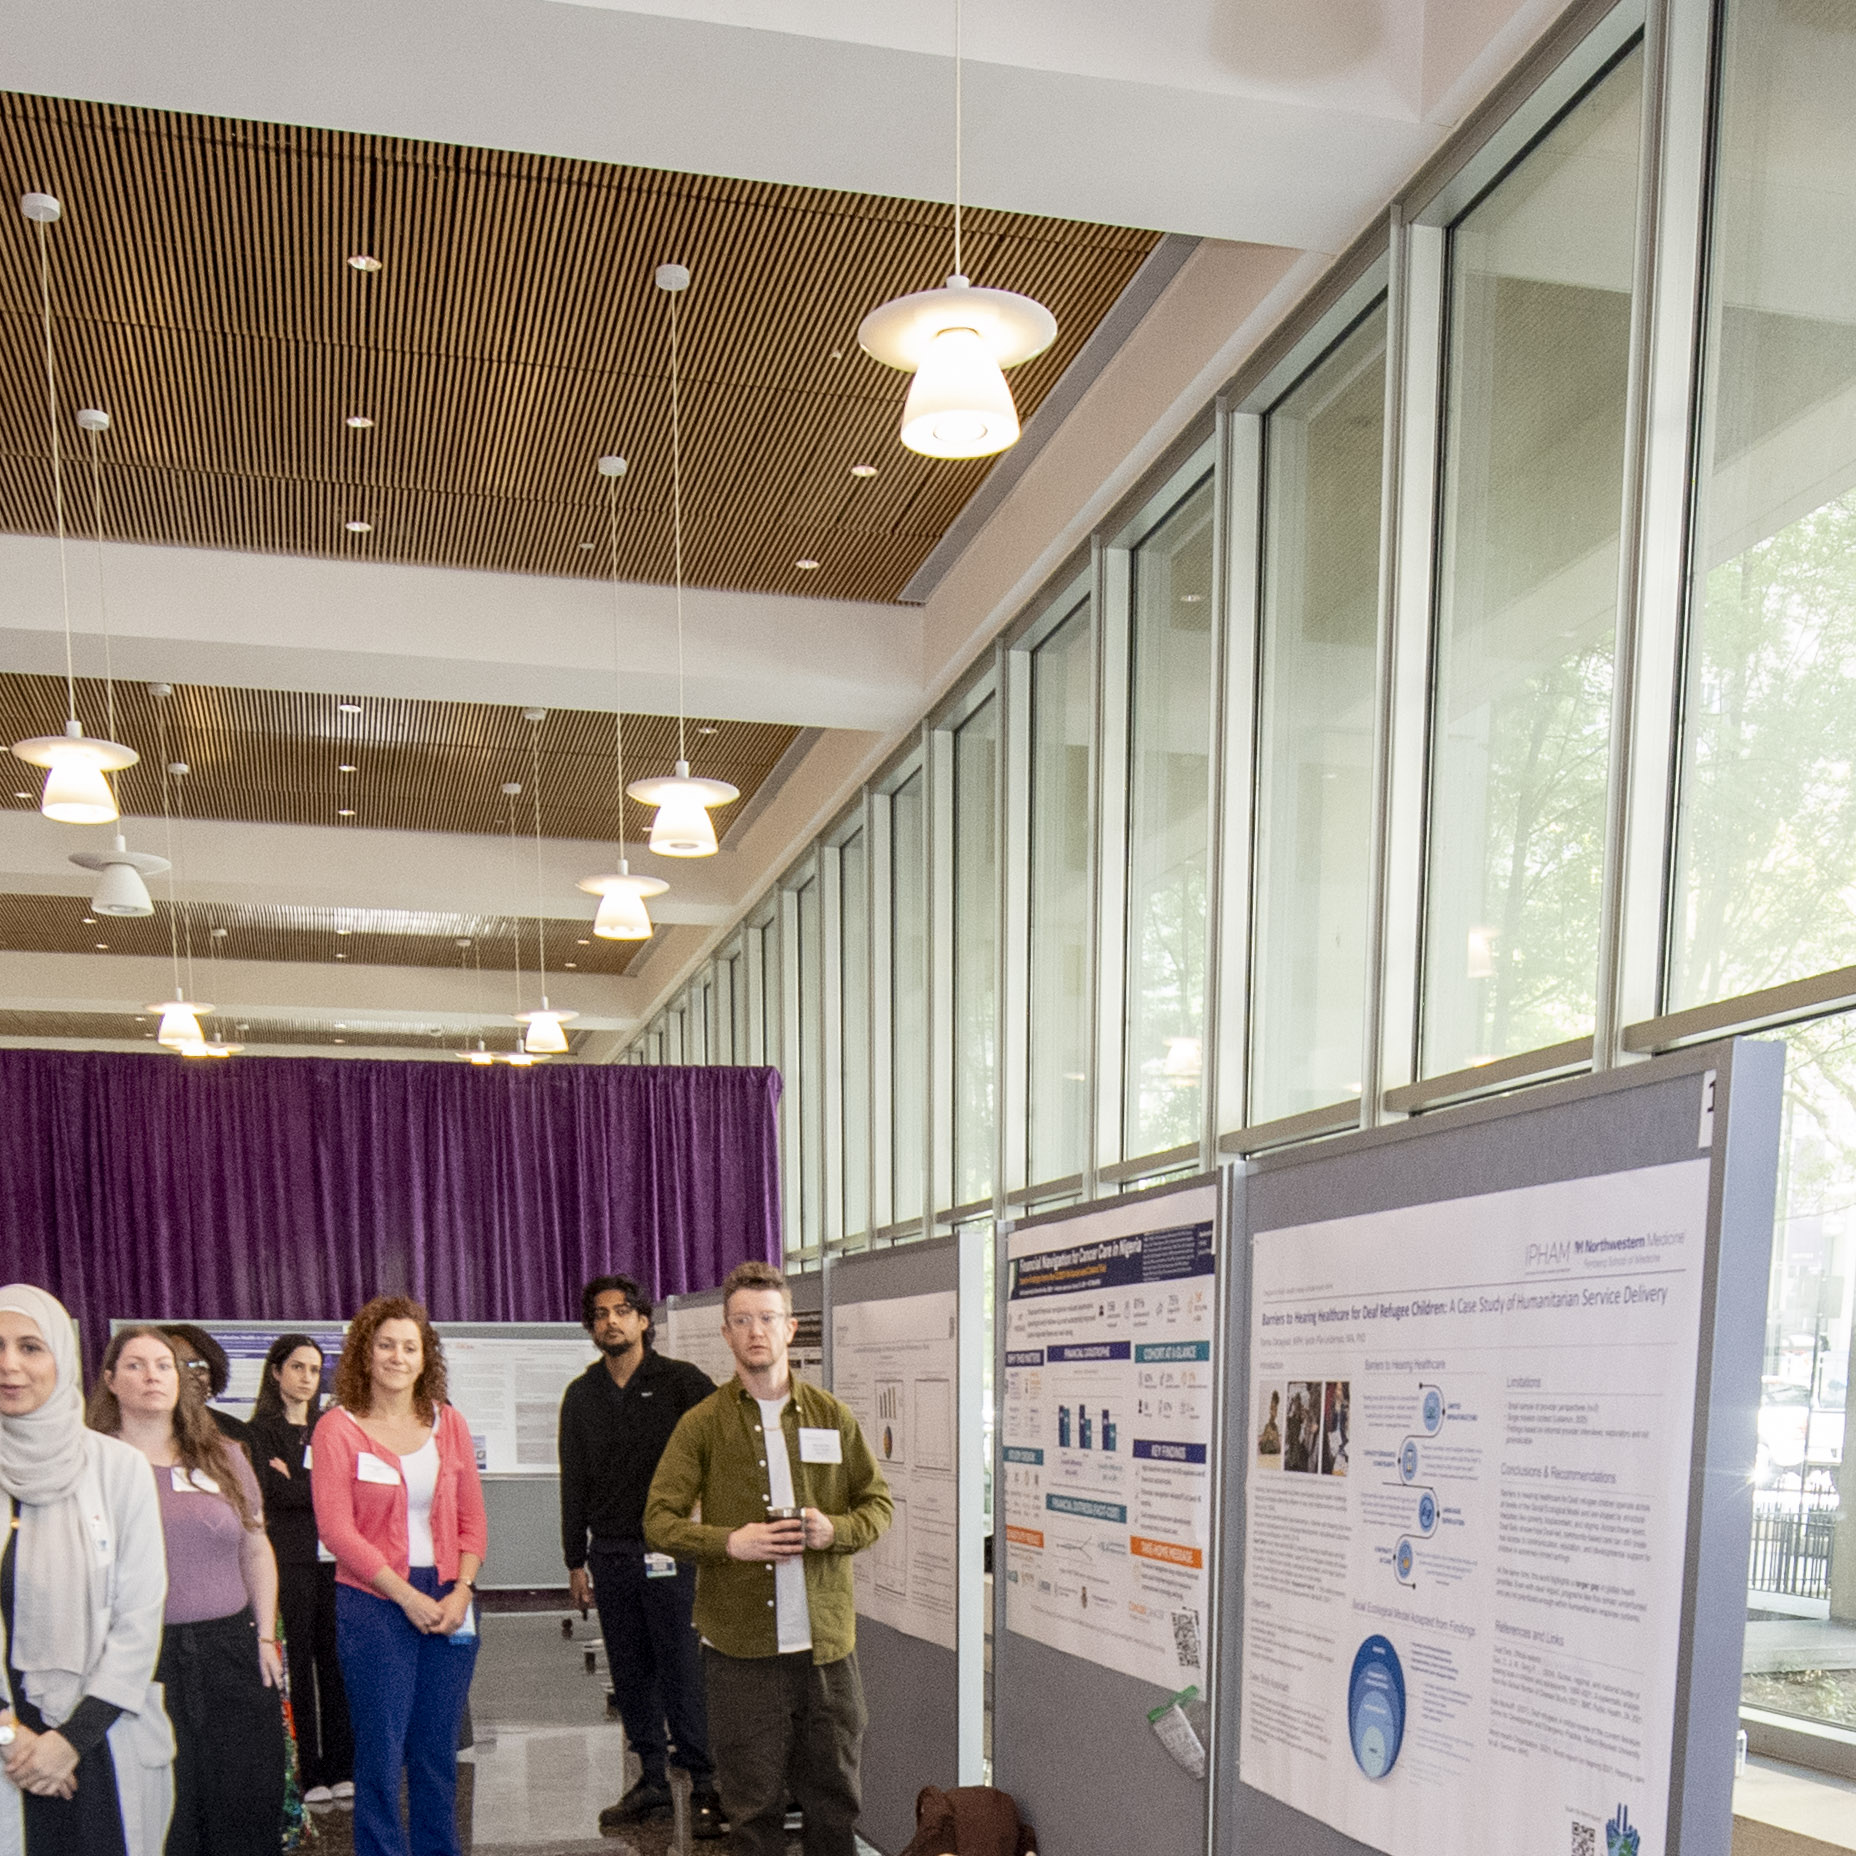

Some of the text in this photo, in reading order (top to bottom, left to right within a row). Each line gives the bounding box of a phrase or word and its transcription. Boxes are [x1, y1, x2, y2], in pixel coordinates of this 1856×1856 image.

[1098, 1242, 1113, 1260] Care
[1119, 1236, 1143, 1260] Nigeria
[1525, 1241, 1571, 1267] IPHAM
[1585, 1237, 1645, 1254] Northwestern
[1262, 1312, 1285, 1327] Barriers
[1295, 1309, 1317, 1327] Hearing
[1318, 1306, 1350, 1323] Healthcare
[1362, 1302, 1379, 1320] Deaf
[1380, 1301, 1410, 1321] Refugee
[1449, 1298, 1456, 1313] A
[1457, 1296, 1477, 1315] Case
[1479, 1295, 1505, 1315] Study
[1506, 1292, 1518, 1312] of
[1518, 1290, 1580, 1310] Humanitarian
[1581, 1287, 1622, 1306] Service
[1623, 1283, 1669, 1306] Delivery
[1500, 1462, 1542, 1478] Conclusions
[1550, 1464, 1617, 1485] Recommendations
